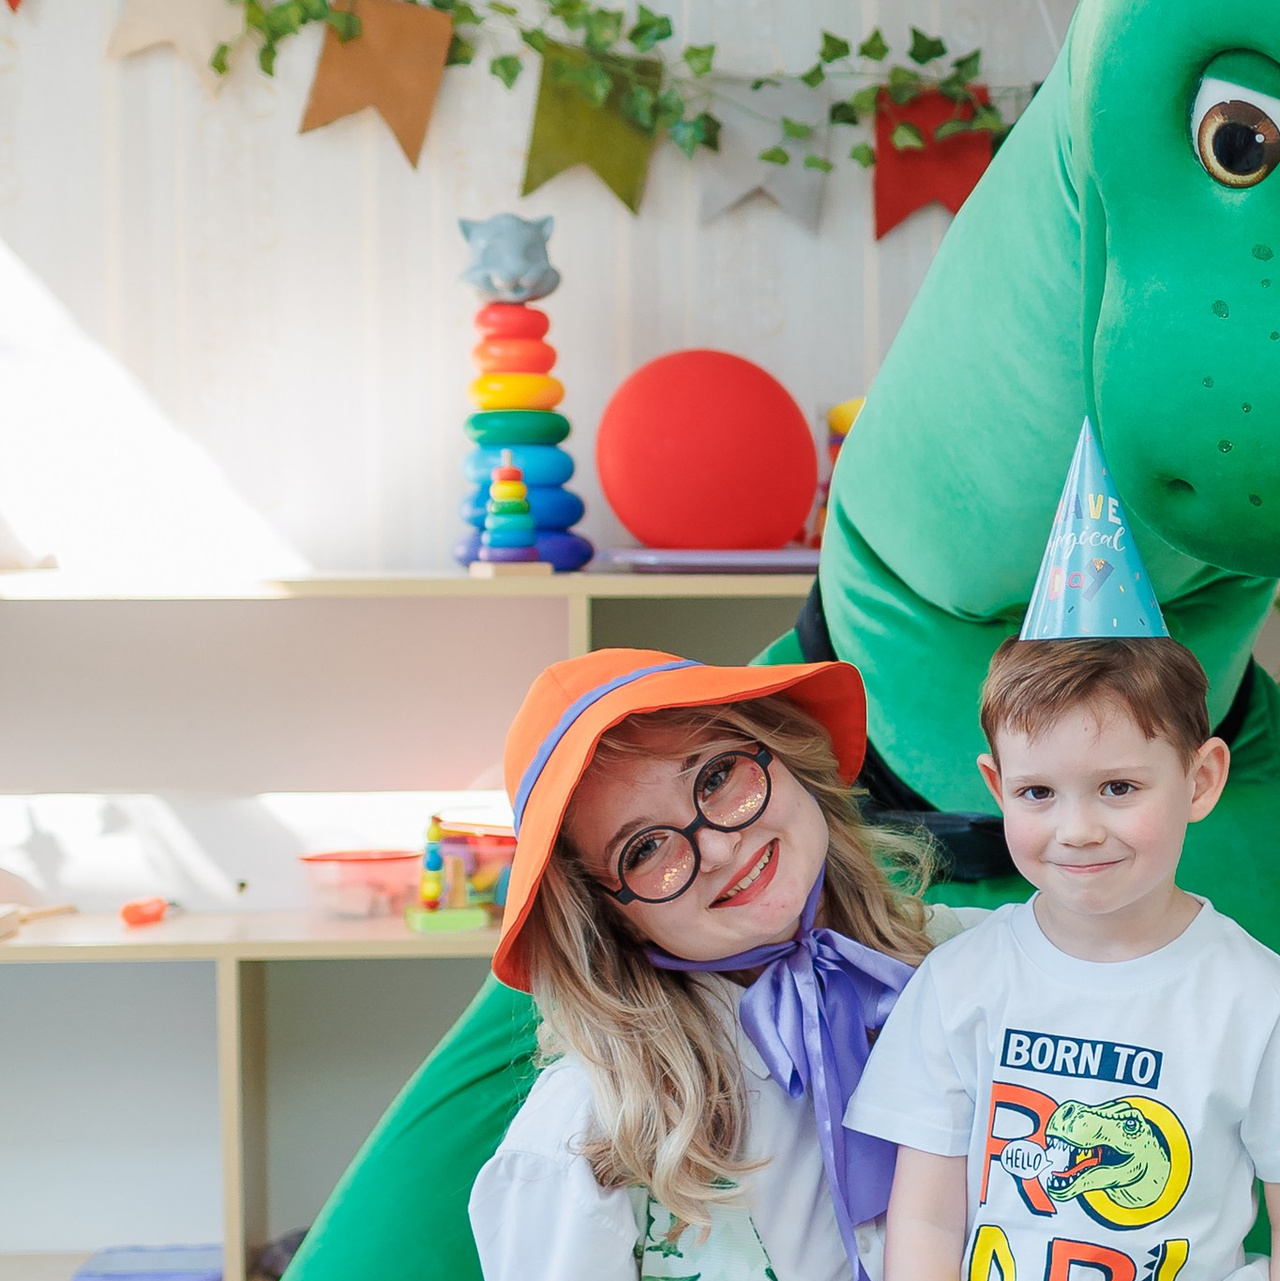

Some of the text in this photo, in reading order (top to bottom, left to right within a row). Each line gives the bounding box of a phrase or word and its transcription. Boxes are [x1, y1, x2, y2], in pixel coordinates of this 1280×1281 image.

[1055, 493, 1122, 526] AVE
[1006, 1033, 1157, 1085] BORN TO
[1005, 1146, 1043, 1172] HELLO
